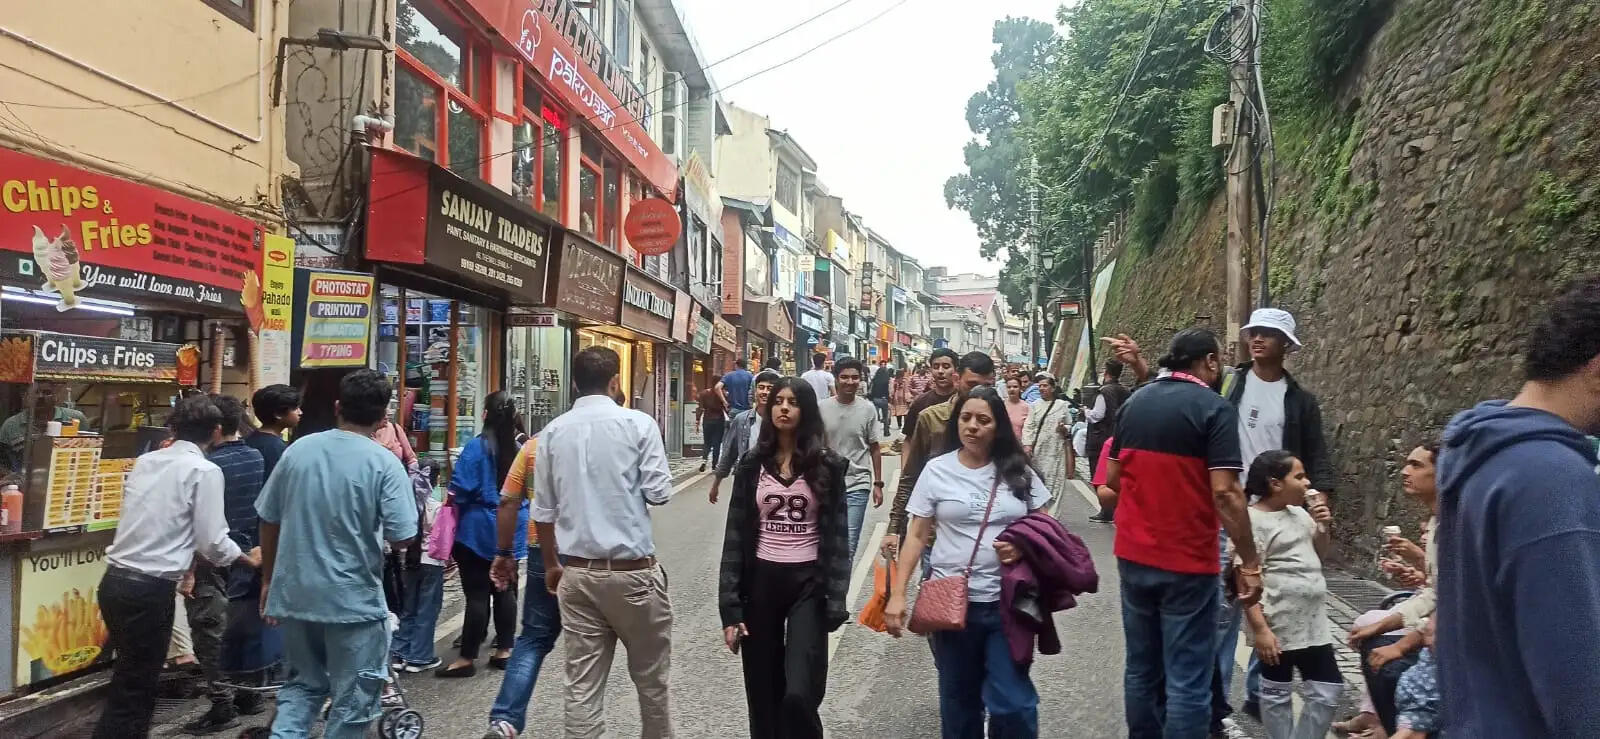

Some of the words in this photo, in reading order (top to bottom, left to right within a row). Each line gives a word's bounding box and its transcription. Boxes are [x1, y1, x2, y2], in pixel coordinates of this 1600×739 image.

[549, 47, 616, 130] pakwaan
[2, 179, 98, 216] Chips
[103, 200, 112, 213] &
[81, 218, 152, 250] Fries
[441, 189, 493, 233] SANJAY
[497, 216, 543, 256] TRADERS
[463, 230, 486, 249] SANITARY
[82, 264, 117, 287] You
[120, 273, 147, 290] will
[149, 276, 174, 295] love
[175, 285, 194, 299] our
[196, 284, 222, 303] Fries
[316, 280, 368, 296] PHOTOSTAT
[262, 291, 291, 305] Pahado
[317, 303, 362, 316] PRINTOUT
[624, 279, 651, 310] INDIAN
[651, 291, 674, 320] TERRAIN
[541, 316, 552, 325] AID
[41, 340, 97, 368] Chips
[102, 352, 109, 365] &
[113, 345, 155, 367] Fries
[320, 344, 352, 357] TYPING
[763, 494, 809, 522] 28
[765, 522, 808, 533] LEGENDS
